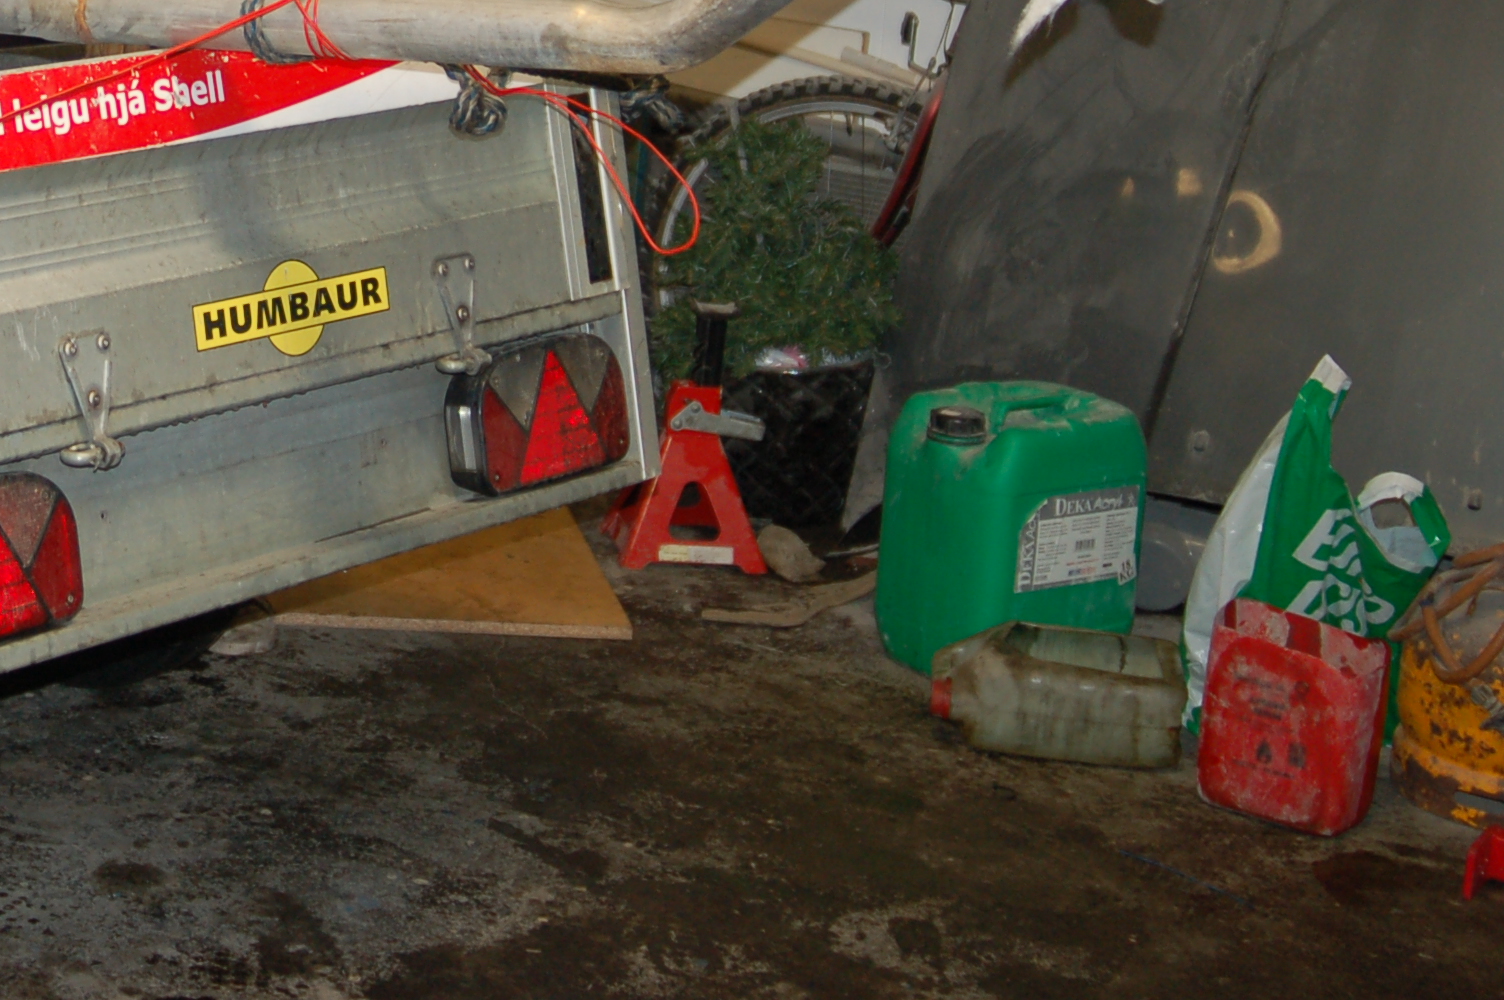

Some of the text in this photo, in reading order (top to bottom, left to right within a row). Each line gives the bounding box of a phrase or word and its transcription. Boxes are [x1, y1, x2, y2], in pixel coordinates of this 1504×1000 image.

[12, 94, 91, 136] leigu
[96, 79, 146, 126] hjá
[153, 69, 225, 112] Shell
[203, 277, 382, 341] HUMBAUR
[1054, 498, 1093, 517] DEKA
